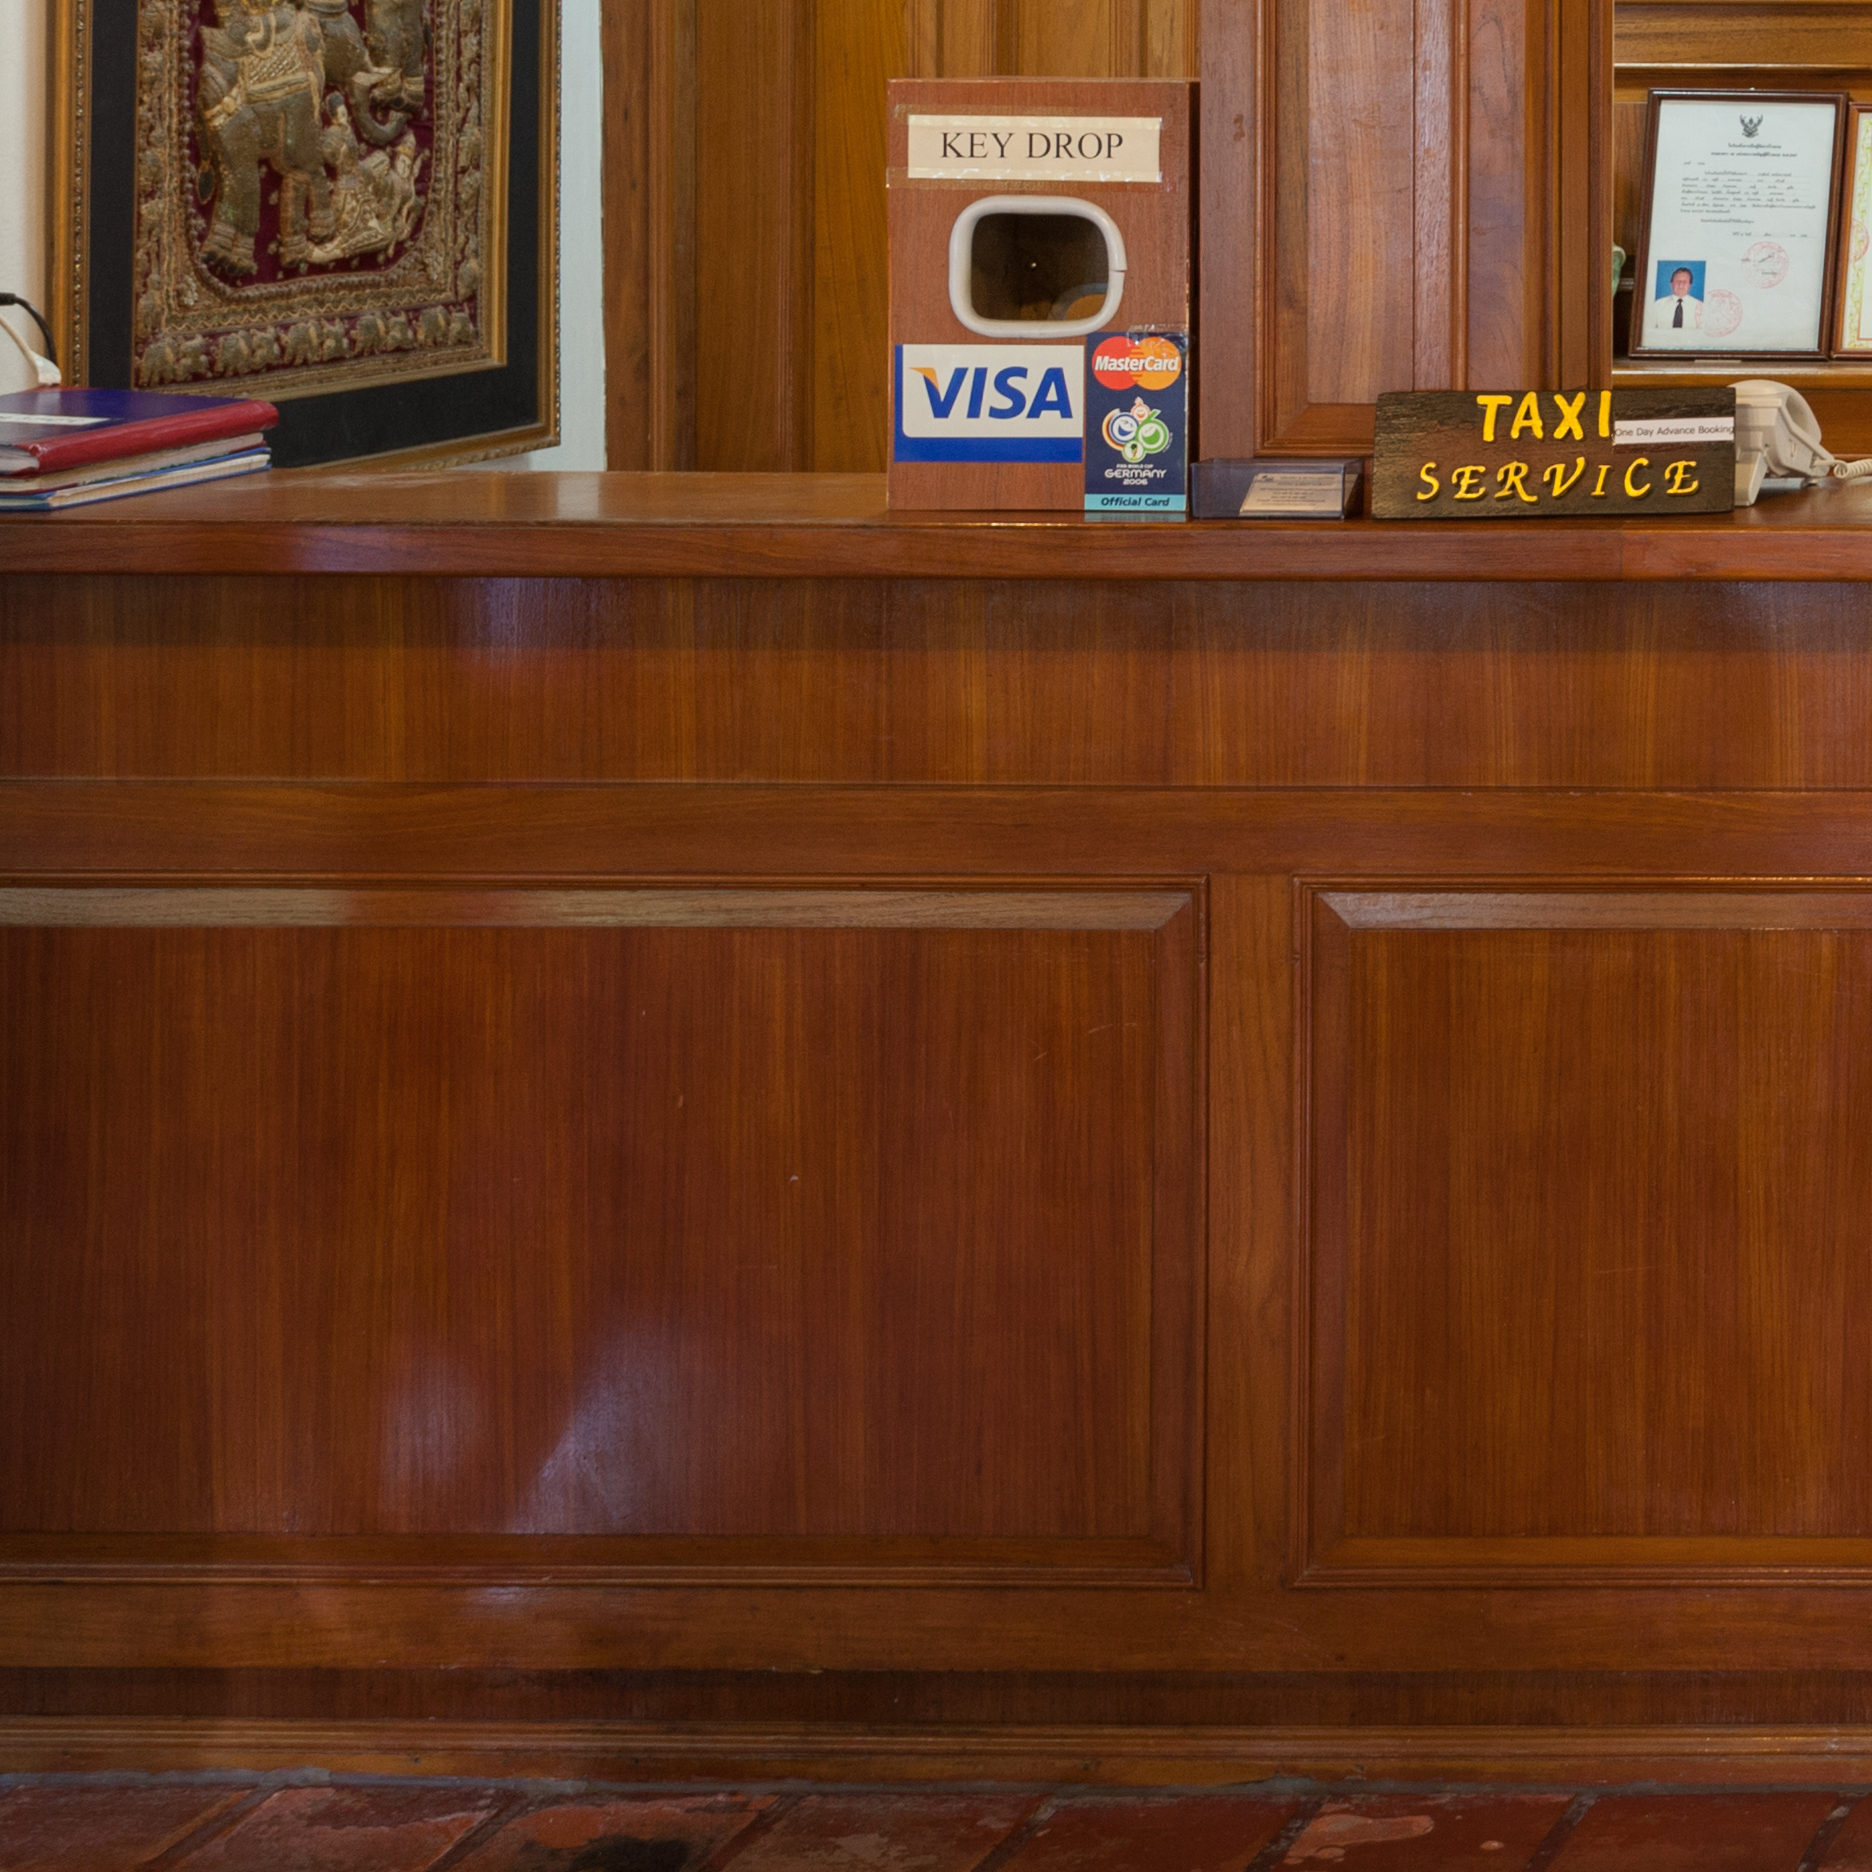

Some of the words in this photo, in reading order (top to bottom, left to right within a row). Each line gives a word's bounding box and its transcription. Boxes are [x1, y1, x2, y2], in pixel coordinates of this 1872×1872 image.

[941, 132, 1015, 159] KEY
[1027, 133, 1124, 159] DROP
[1095, 356, 1179, 371] MasterCard
[909, 366, 1073, 419] VISA
[1476, 390, 1611, 442] TAXI
[1615, 428, 1633, 437] One
[1636, 427, 1653, 437] Day
[1656, 426, 1695, 436] Advance
[1698, 425, 1734, 437] Booking
[1105, 468, 1167, 478] GERMANY
[1417, 457, 1699, 502] SERVICE
[1101, 498, 1142, 506] Official
[1145, 498, 1170, 506] Card
